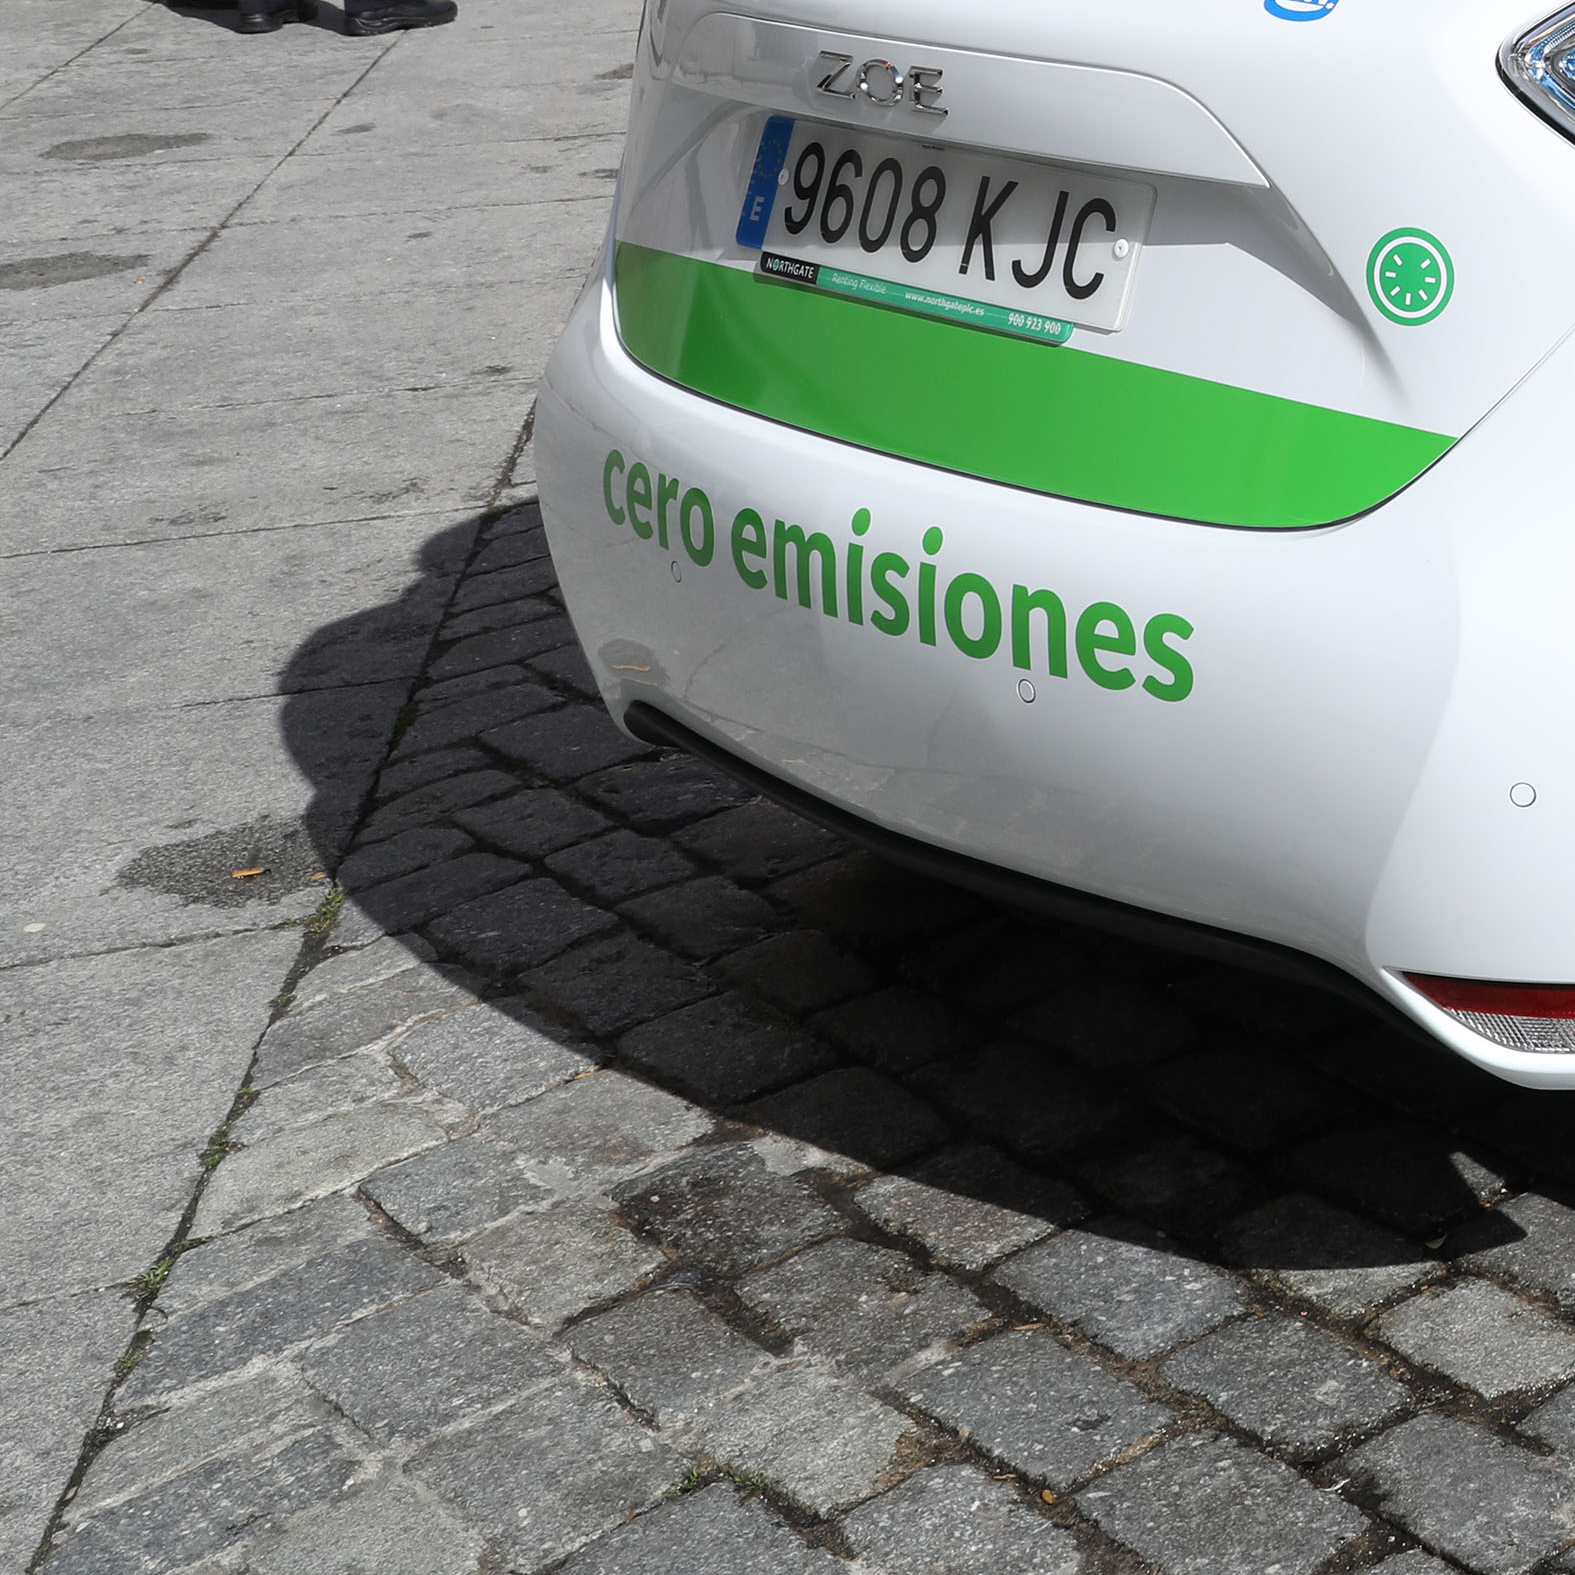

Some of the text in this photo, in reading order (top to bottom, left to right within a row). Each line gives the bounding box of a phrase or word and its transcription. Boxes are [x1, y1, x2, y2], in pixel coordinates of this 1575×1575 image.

[817, 50, 948, 115] ZOE
[749, 196, 765, 222] E
[784, 142, 947, 263] 9608
[766, 257, 815, 278] NORTHGATE
[832, 273, 858, 290] Renting
[858, 278, 887, 295] Flexible
[1008, 312, 1024, 327] 900
[1026, 316, 1042, 331] 923
[1044, 320, 1062, 335] 900
[603, 449, 1194, 702] cero emisiones
